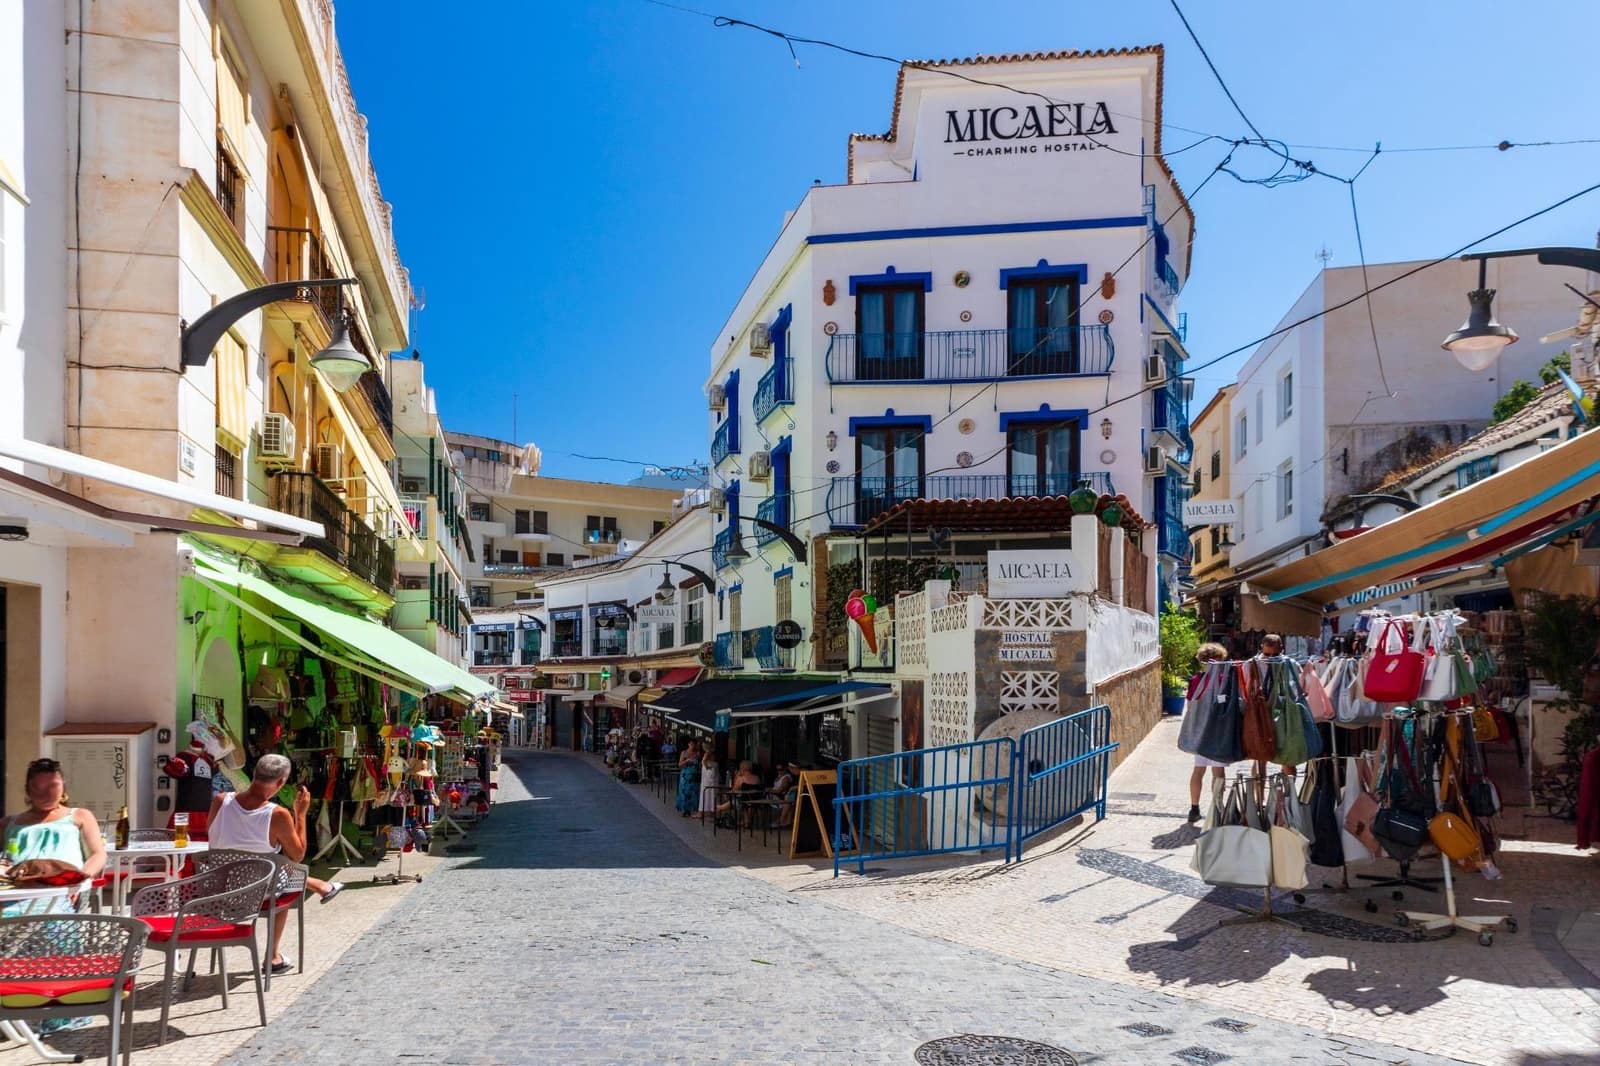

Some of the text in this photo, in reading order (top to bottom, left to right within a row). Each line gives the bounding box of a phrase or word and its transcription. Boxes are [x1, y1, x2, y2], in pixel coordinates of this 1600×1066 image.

[944, 102, 1119, 143] MICAELA
[967, 142, 1096, 157] CHARMING HOSTAL
[1005, 633, 1049, 643] HOSTAL
[1001, 649, 1053, 660] MICAELA
